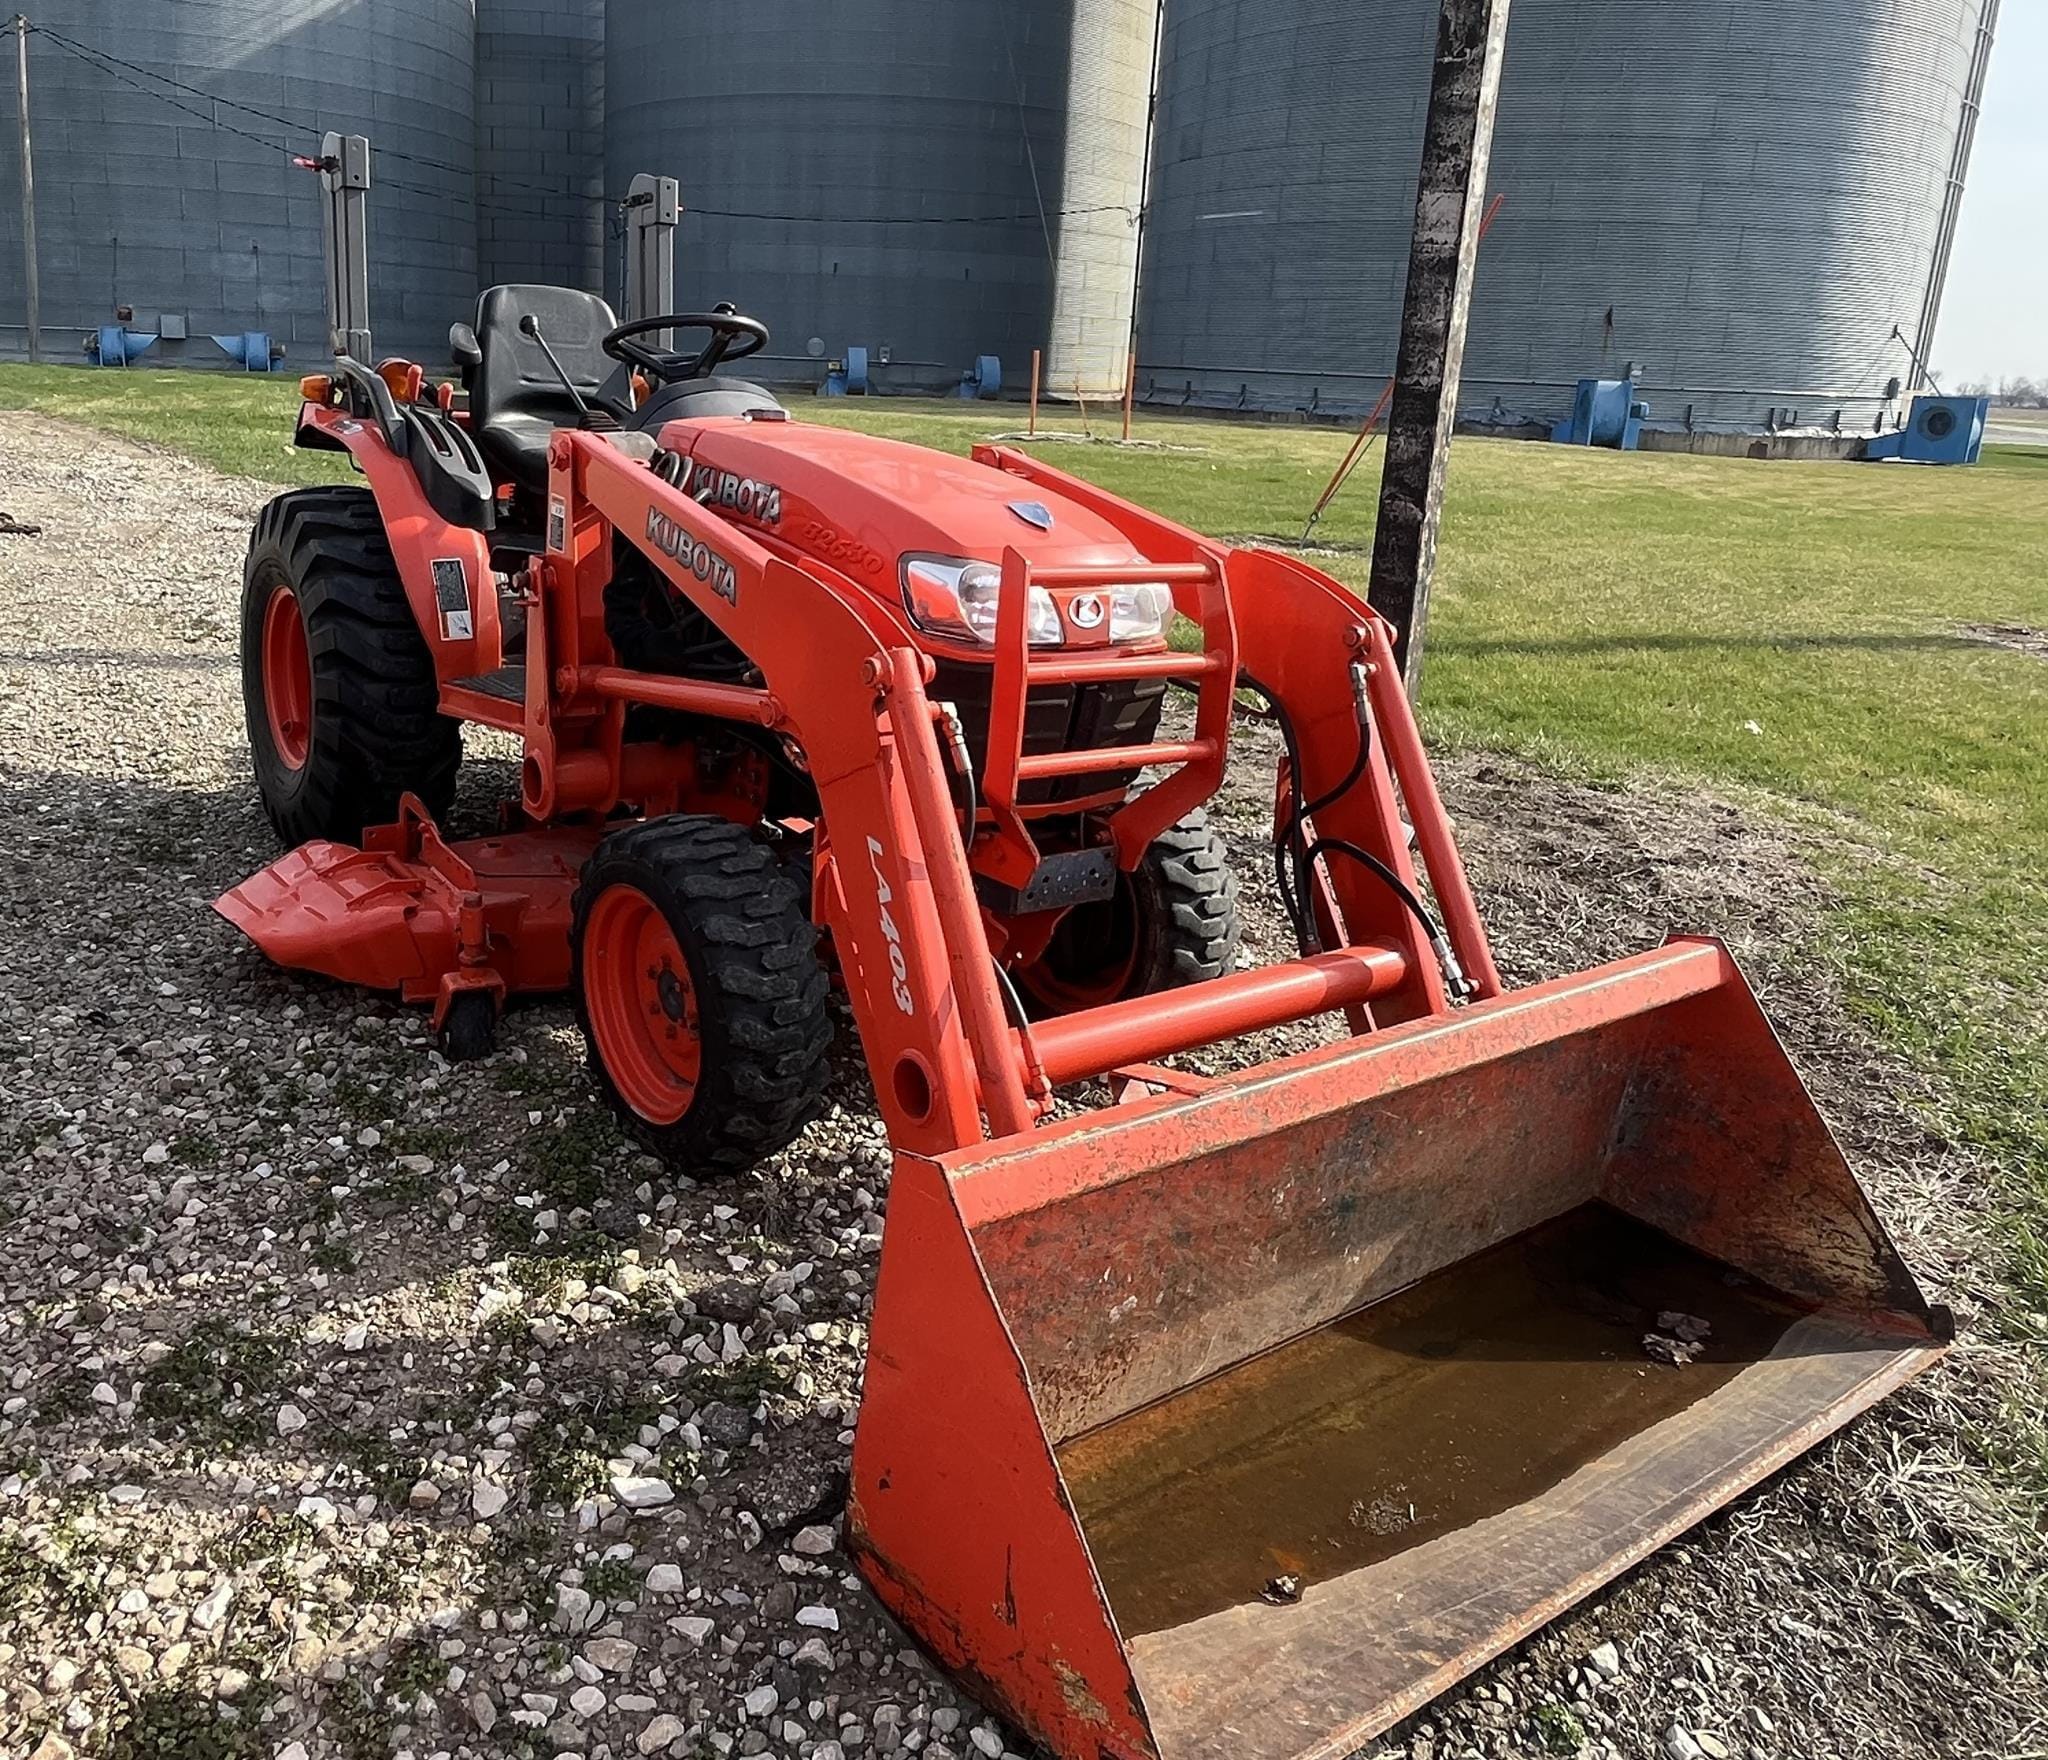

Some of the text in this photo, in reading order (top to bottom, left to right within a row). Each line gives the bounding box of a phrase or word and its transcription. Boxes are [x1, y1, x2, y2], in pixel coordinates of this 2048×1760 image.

[693, 464, 781, 524] KUBOTA
[646, 505, 736, 607] KUBOTA
[867, 836, 914, 1016] LA403
